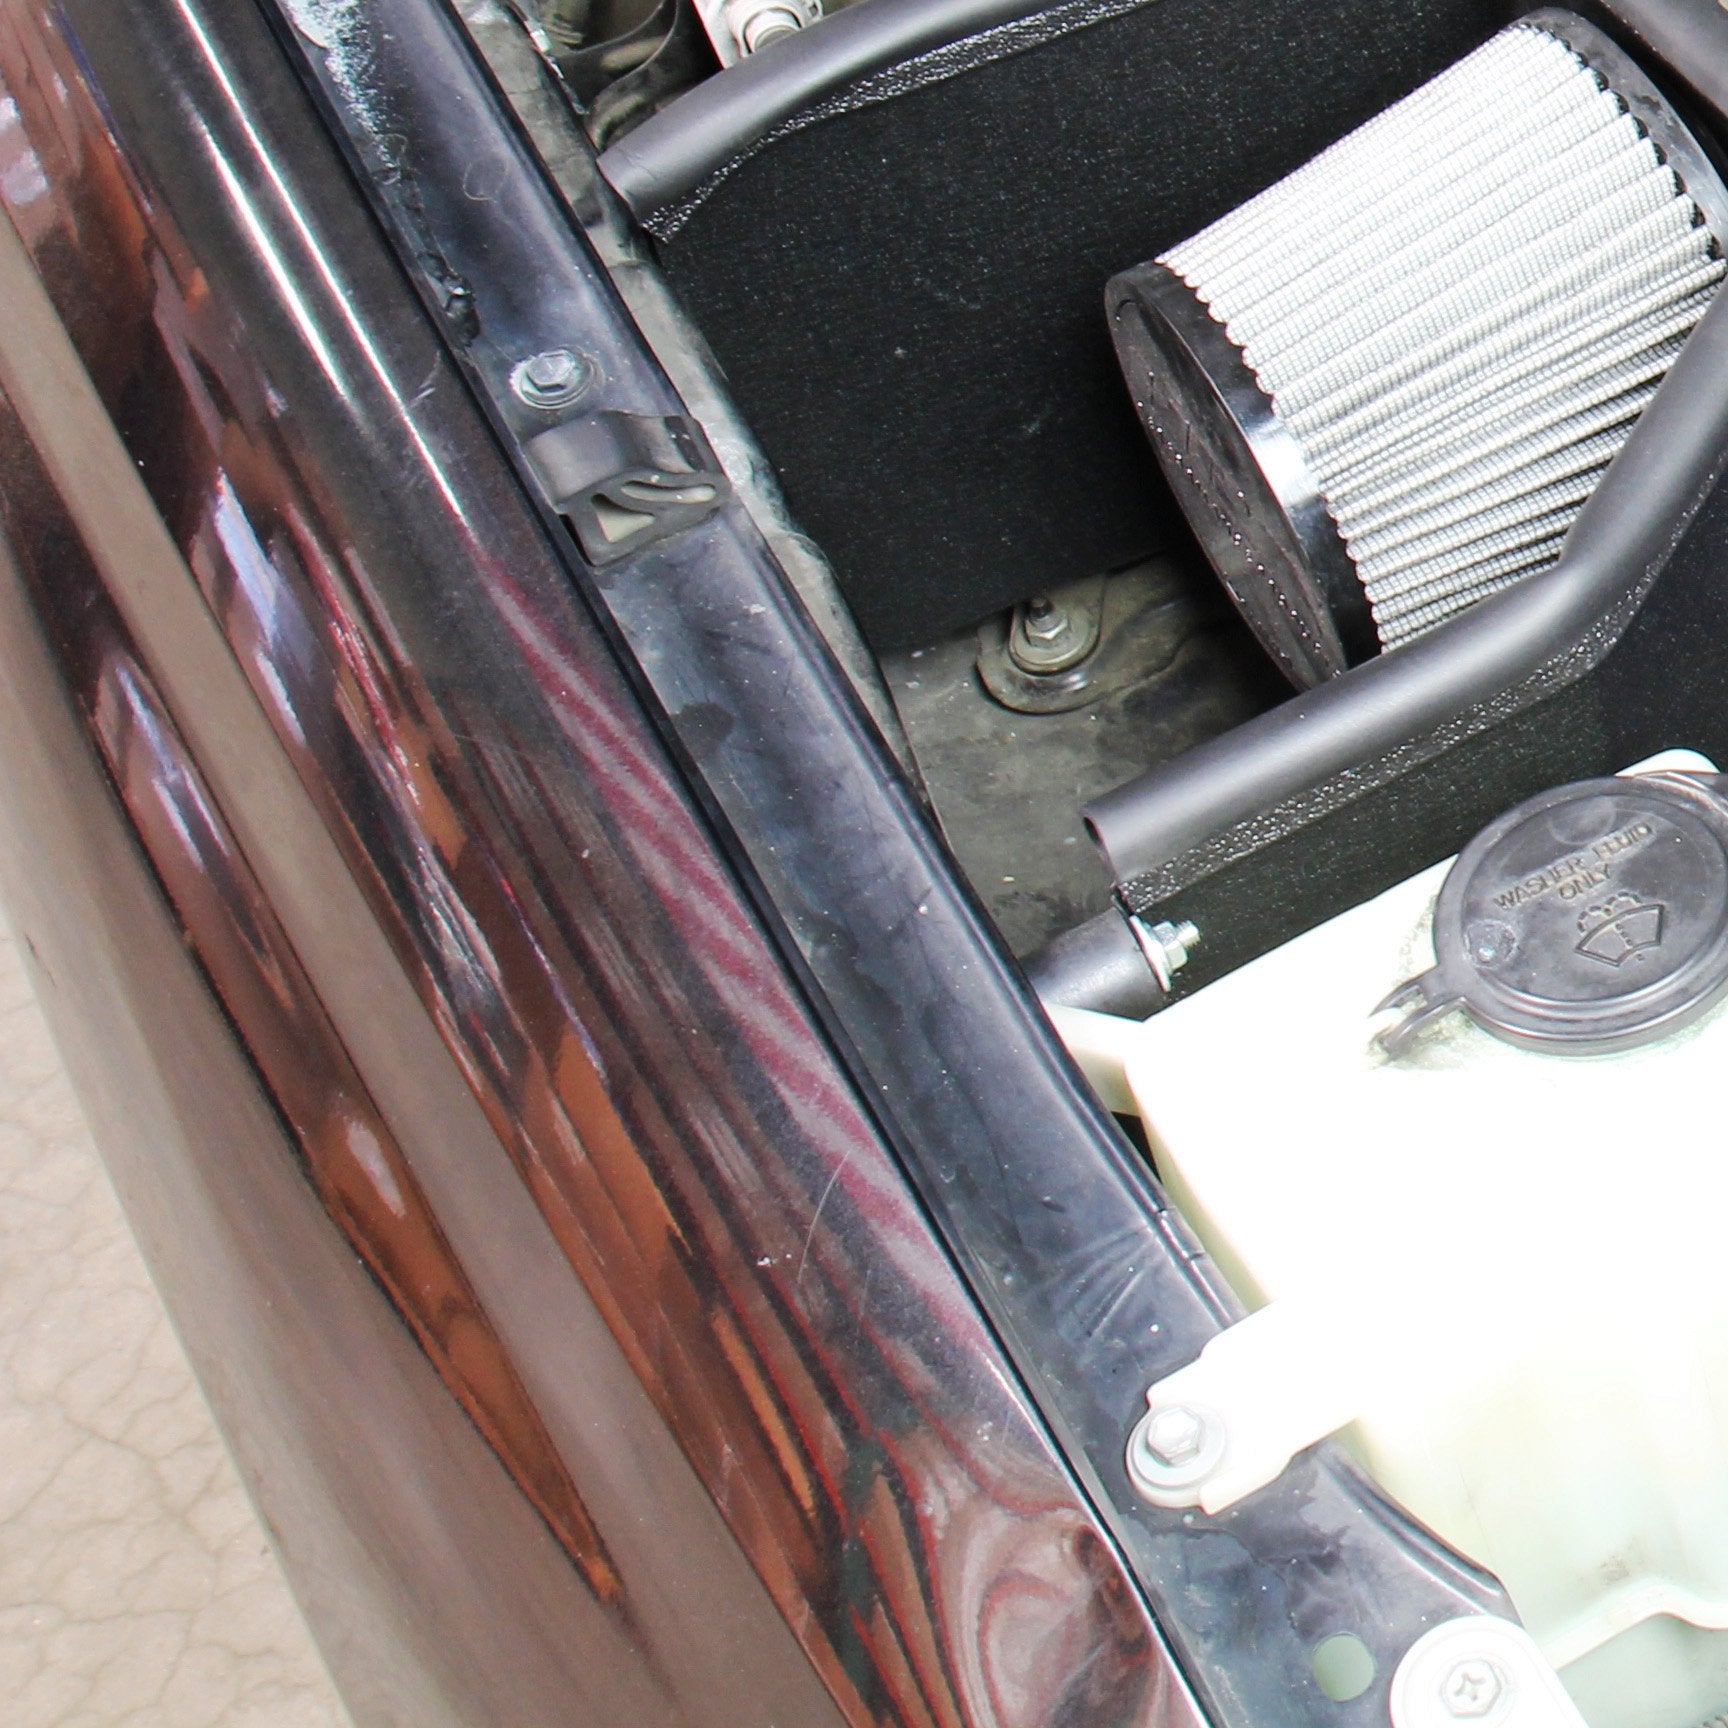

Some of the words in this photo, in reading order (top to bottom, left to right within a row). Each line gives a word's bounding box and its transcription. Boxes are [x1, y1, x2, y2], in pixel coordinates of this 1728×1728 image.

[1494, 855, 1588, 912] WASHER
[1588, 820, 1655, 861] FLUID
[1558, 863, 1613, 903] ONLY
